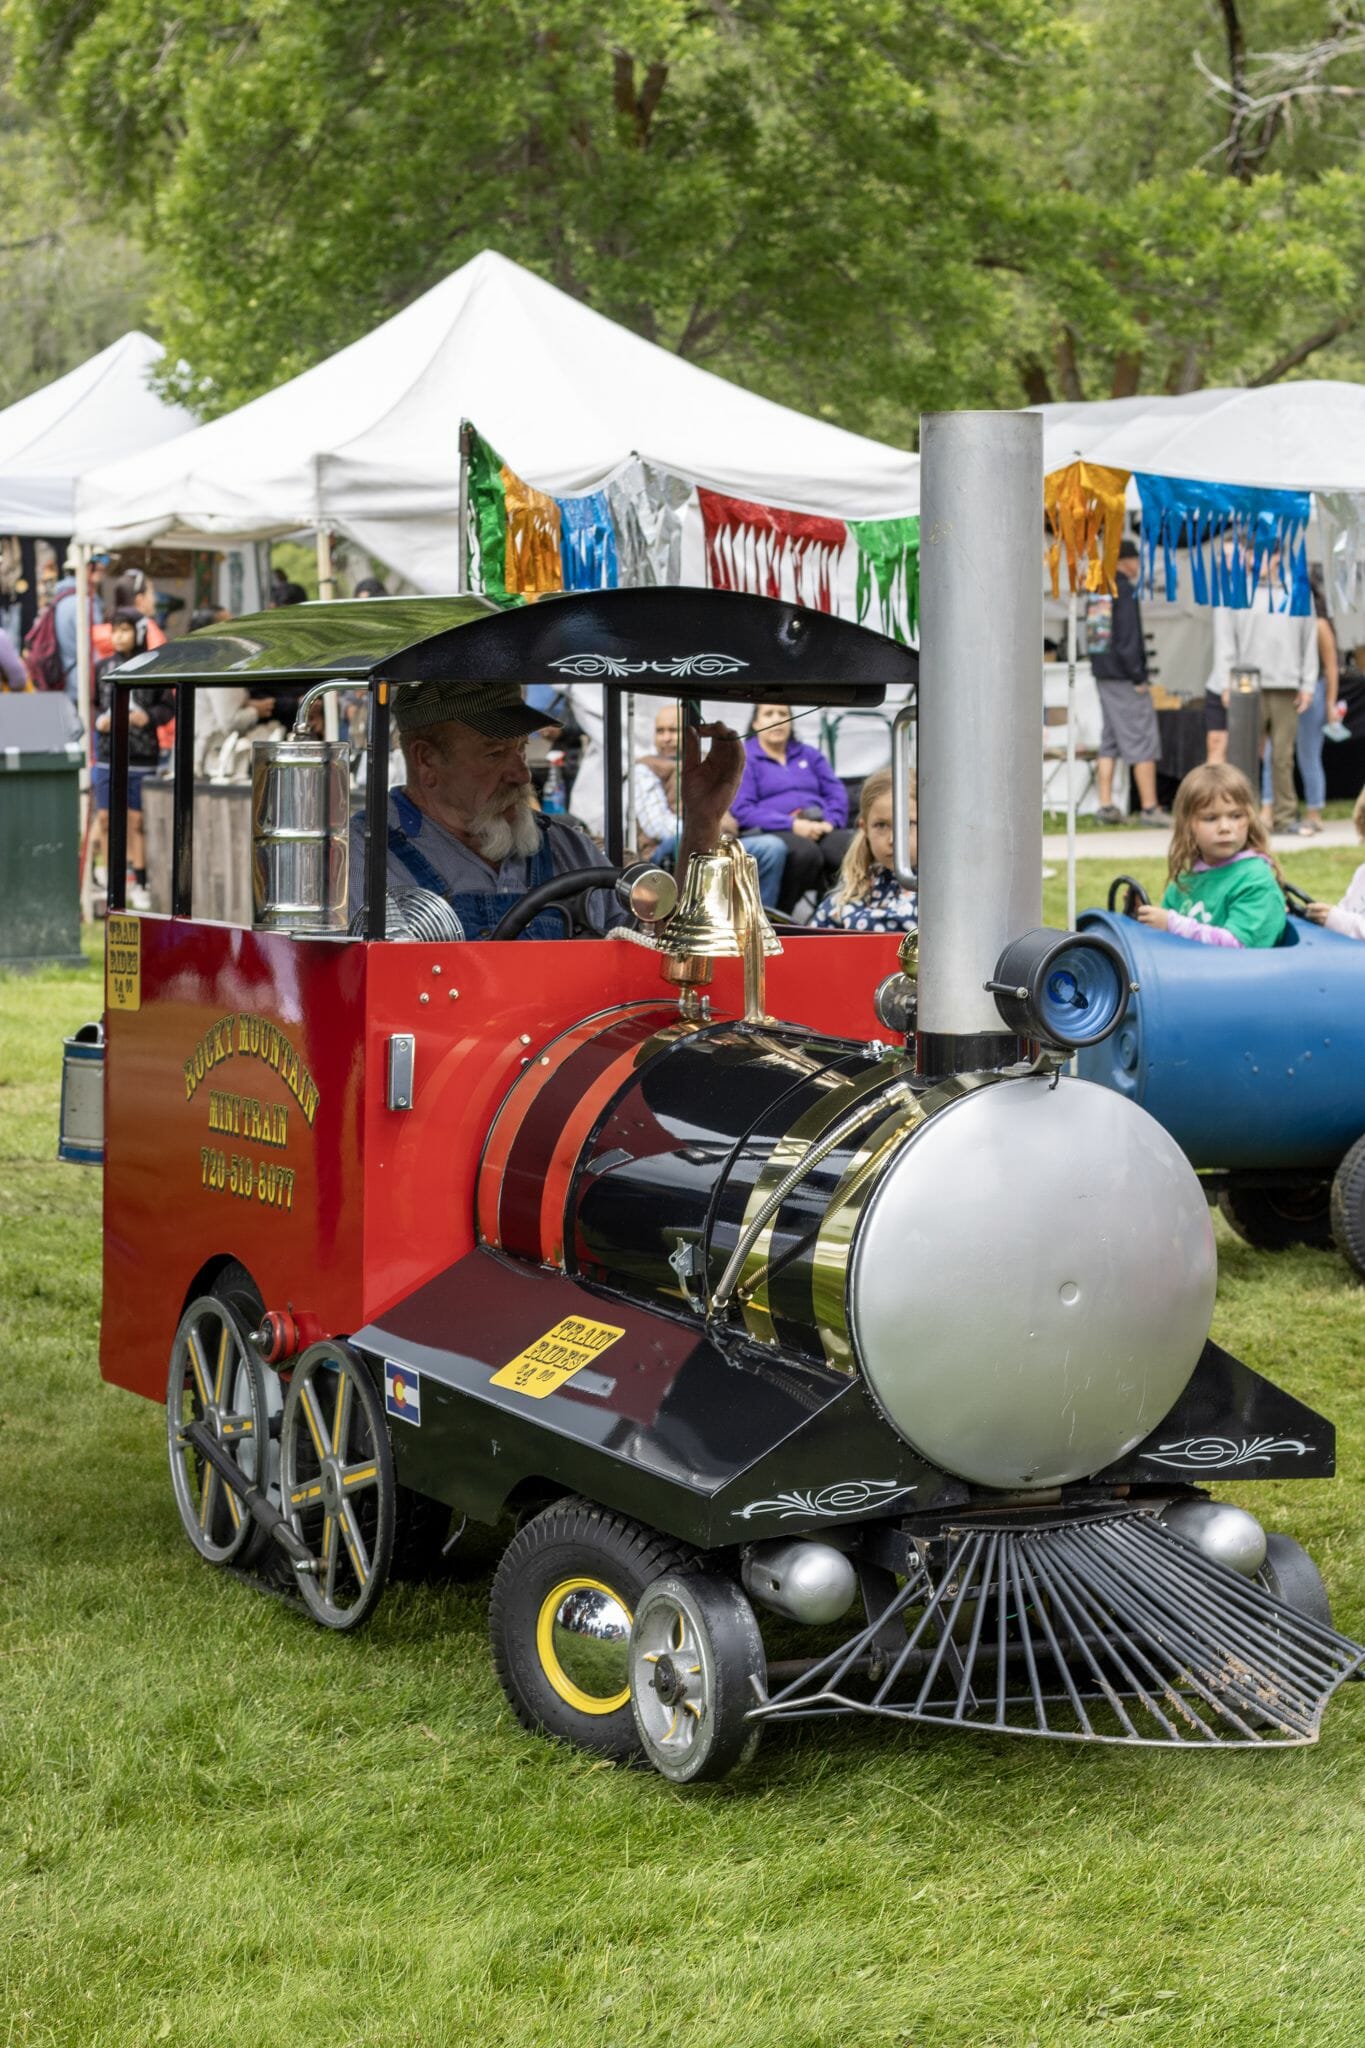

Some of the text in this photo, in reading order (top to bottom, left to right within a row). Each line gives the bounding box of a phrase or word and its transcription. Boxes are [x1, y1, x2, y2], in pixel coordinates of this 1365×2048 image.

[109, 922, 138, 945] TRAIN
[109, 949, 138, 975] RIDES
[183, 1012, 320, 1128] ROCKY MOUNTAIN
[208, 1090, 289, 1150] MINI TRAIN
[201, 1146, 295, 1212] 720-519-8077
[551, 1319, 618, 1350] TRAIN
[523, 1341, 590, 1371] RIDES
